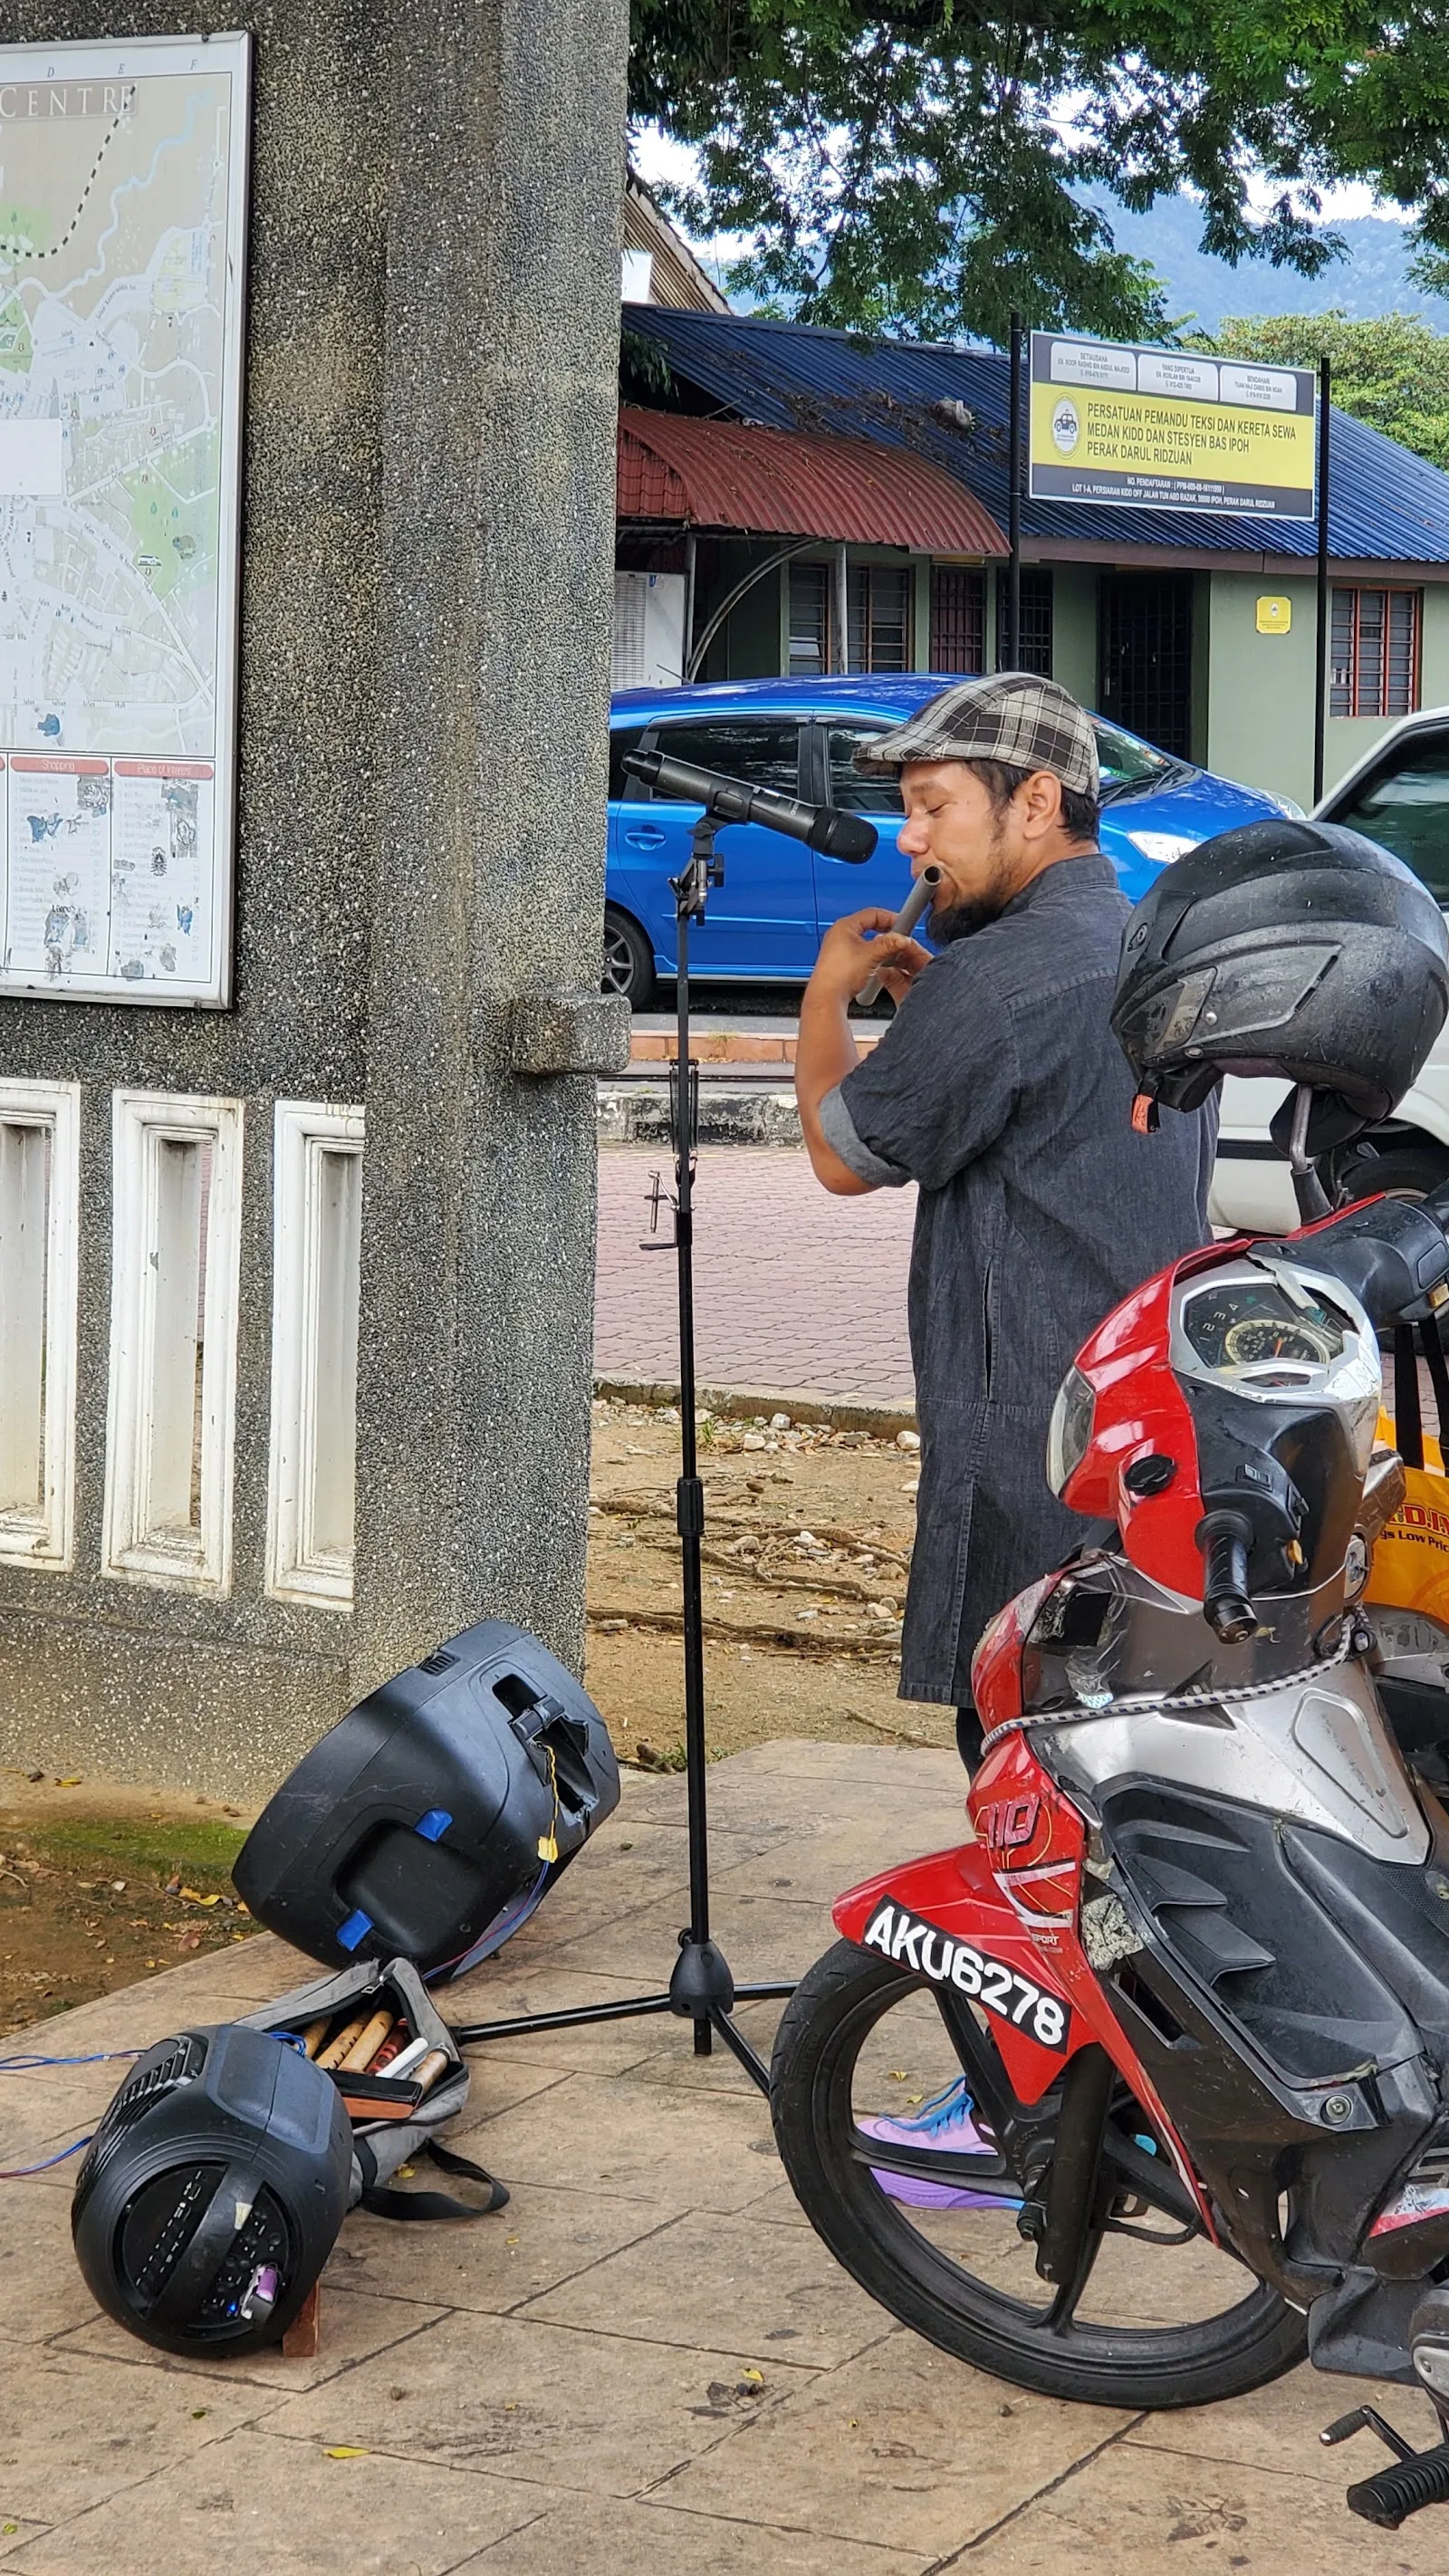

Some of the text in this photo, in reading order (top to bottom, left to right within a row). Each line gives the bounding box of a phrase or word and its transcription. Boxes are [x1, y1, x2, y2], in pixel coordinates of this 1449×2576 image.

[118, 63, 125, 74] E
[190, 59, 197, 71] F
[0, 85, 132, 117] CENTRE
[1087, 403, 1296, 440] PERSATUAN PEMANDU TEKSI DAN KERETA SEWA
[1087, 422, 1120, 438] MEDAN
[1122, 426, 1144, 441] KIDD
[1147, 428, 1165, 444] DAN
[1166, 431, 1207, 448] STESYEN
[1209, 436, 1227, 450] BAS
[1229, 438, 1250, 453] IPOH
[1087, 441, 1192, 465] PERAK DARUL RIDZUAN
[1127, 476, 1136, 485] NO.
[1137, 477, 1171, 488] PENDAFTARAN
[1072, 483, 1082, 493] LOT
[1092, 485, 1120, 495] PERSIARAN
[1121, 487, 1132, 496] KIDD
[1133, 489, 1143, 497] OFF
[1143, 490, 1159, 499] JALAN
[1159, 491, 1169, 500] TUN
[1180, 494, 1197, 504] RAZAK,
[1211, 495, 1223, 505] IPOH,
[1223, 496, 1239, 505] PERAK
[1240, 497, 1254, 507] DARUL
[1255, 499, 1275, 509] RIDZUAN
[42, 758, 75, 773] Shopping
[138, 763, 192, 775] Place of Interest
[1398, 1529, 1425, 1543] Low
[987, 1793, 1041, 1849] 110
[1031, 1933, 1060, 1946] SPORT
[864, 1905, 1065, 2045] AKU6278
